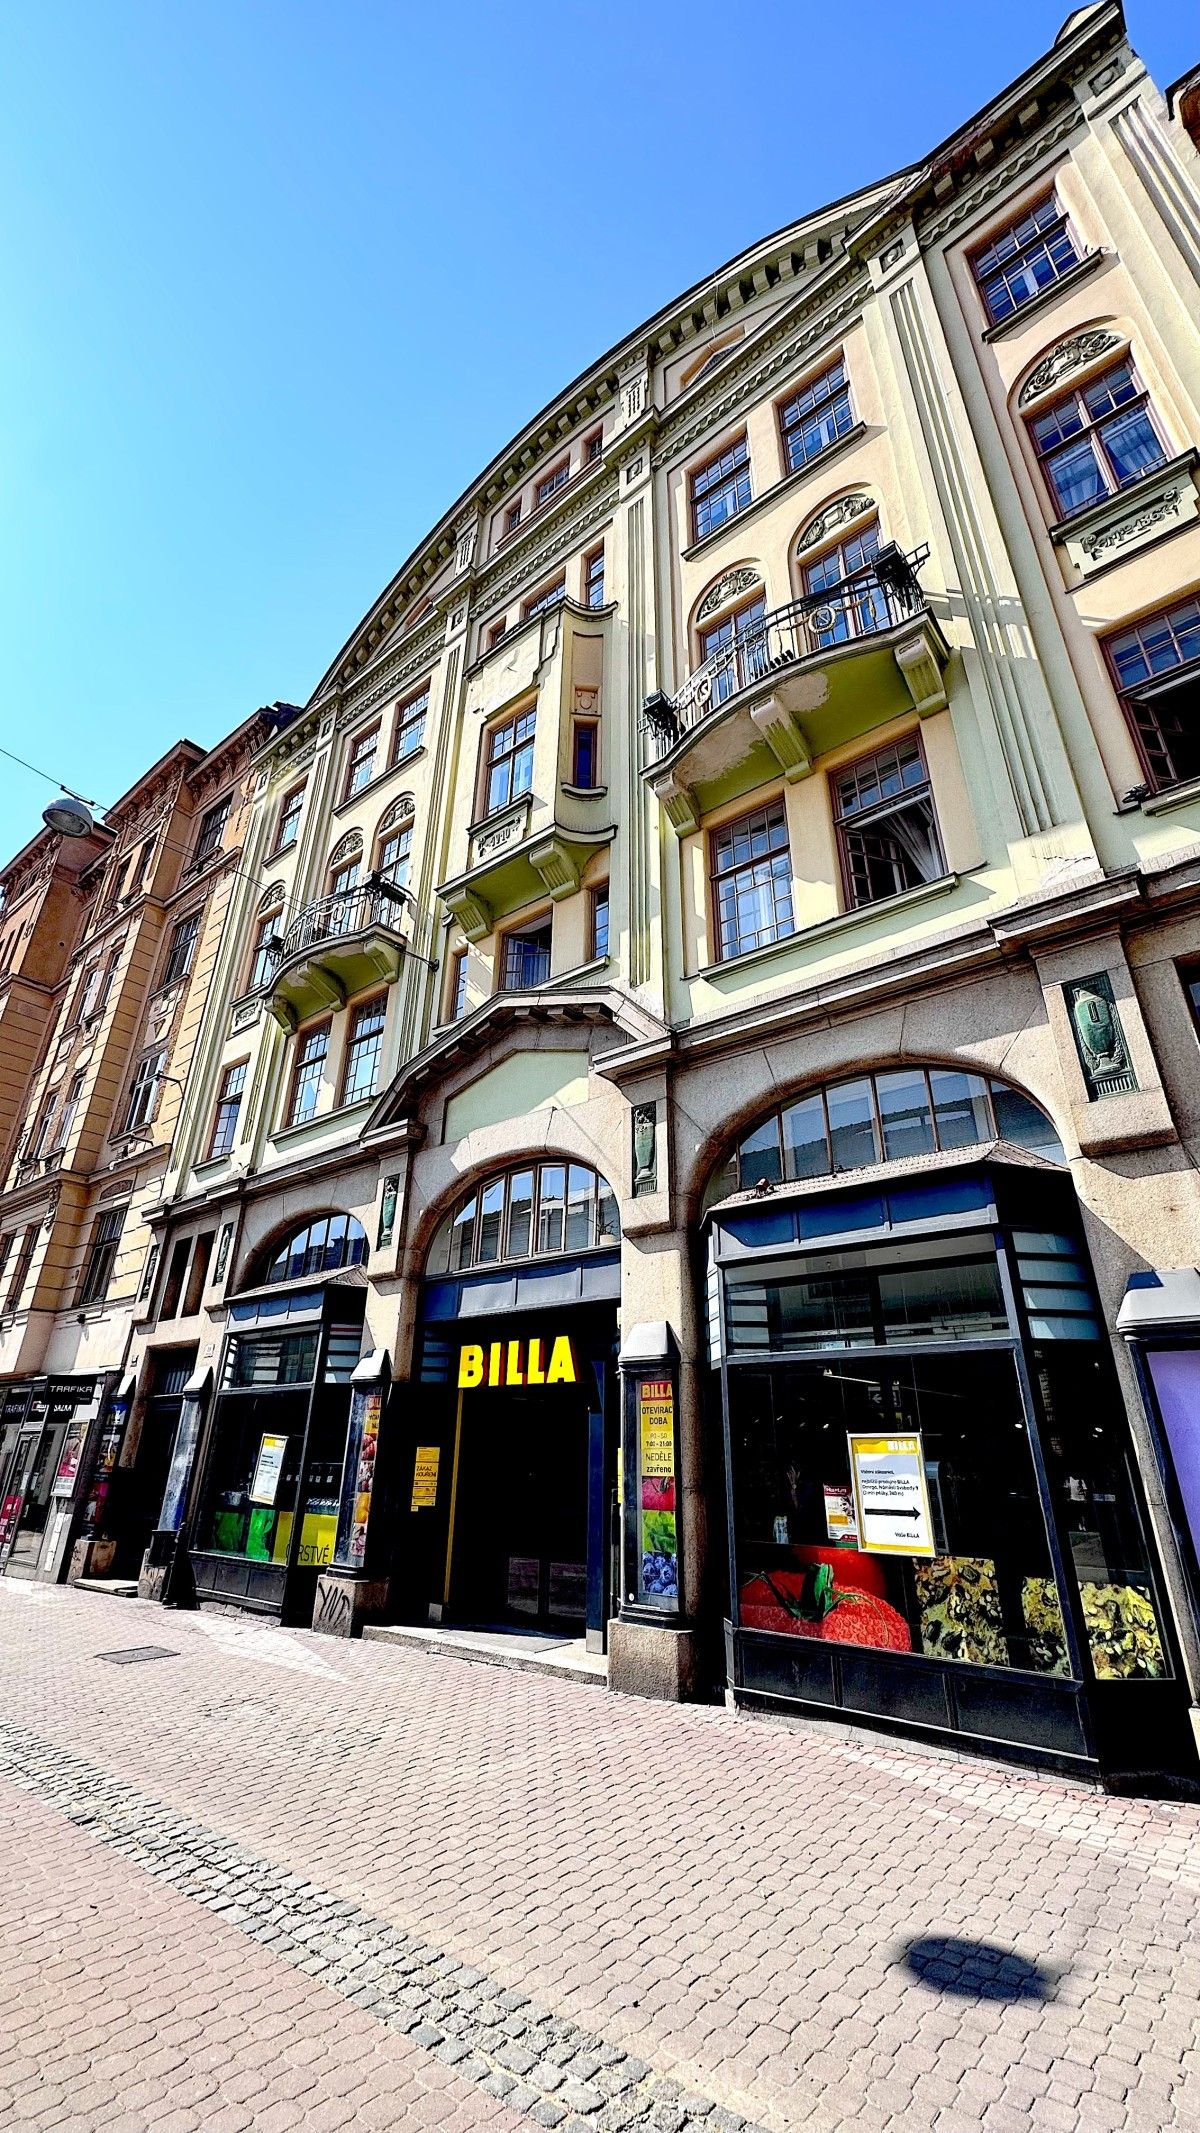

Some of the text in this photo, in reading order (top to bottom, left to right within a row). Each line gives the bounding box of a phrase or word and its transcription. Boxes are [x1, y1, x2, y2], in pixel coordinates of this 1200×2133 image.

[457, 1335, 577, 1388] BILLA
[50, 1385, 93, 1393] TRAFIKA
[641, 1384, 673, 1398] BILLA
[649, 1417, 668, 1425] DOBA
[646, 1451, 672, 1461] NEDĚLE
[646, 1464, 672, 1473] zavřeno
